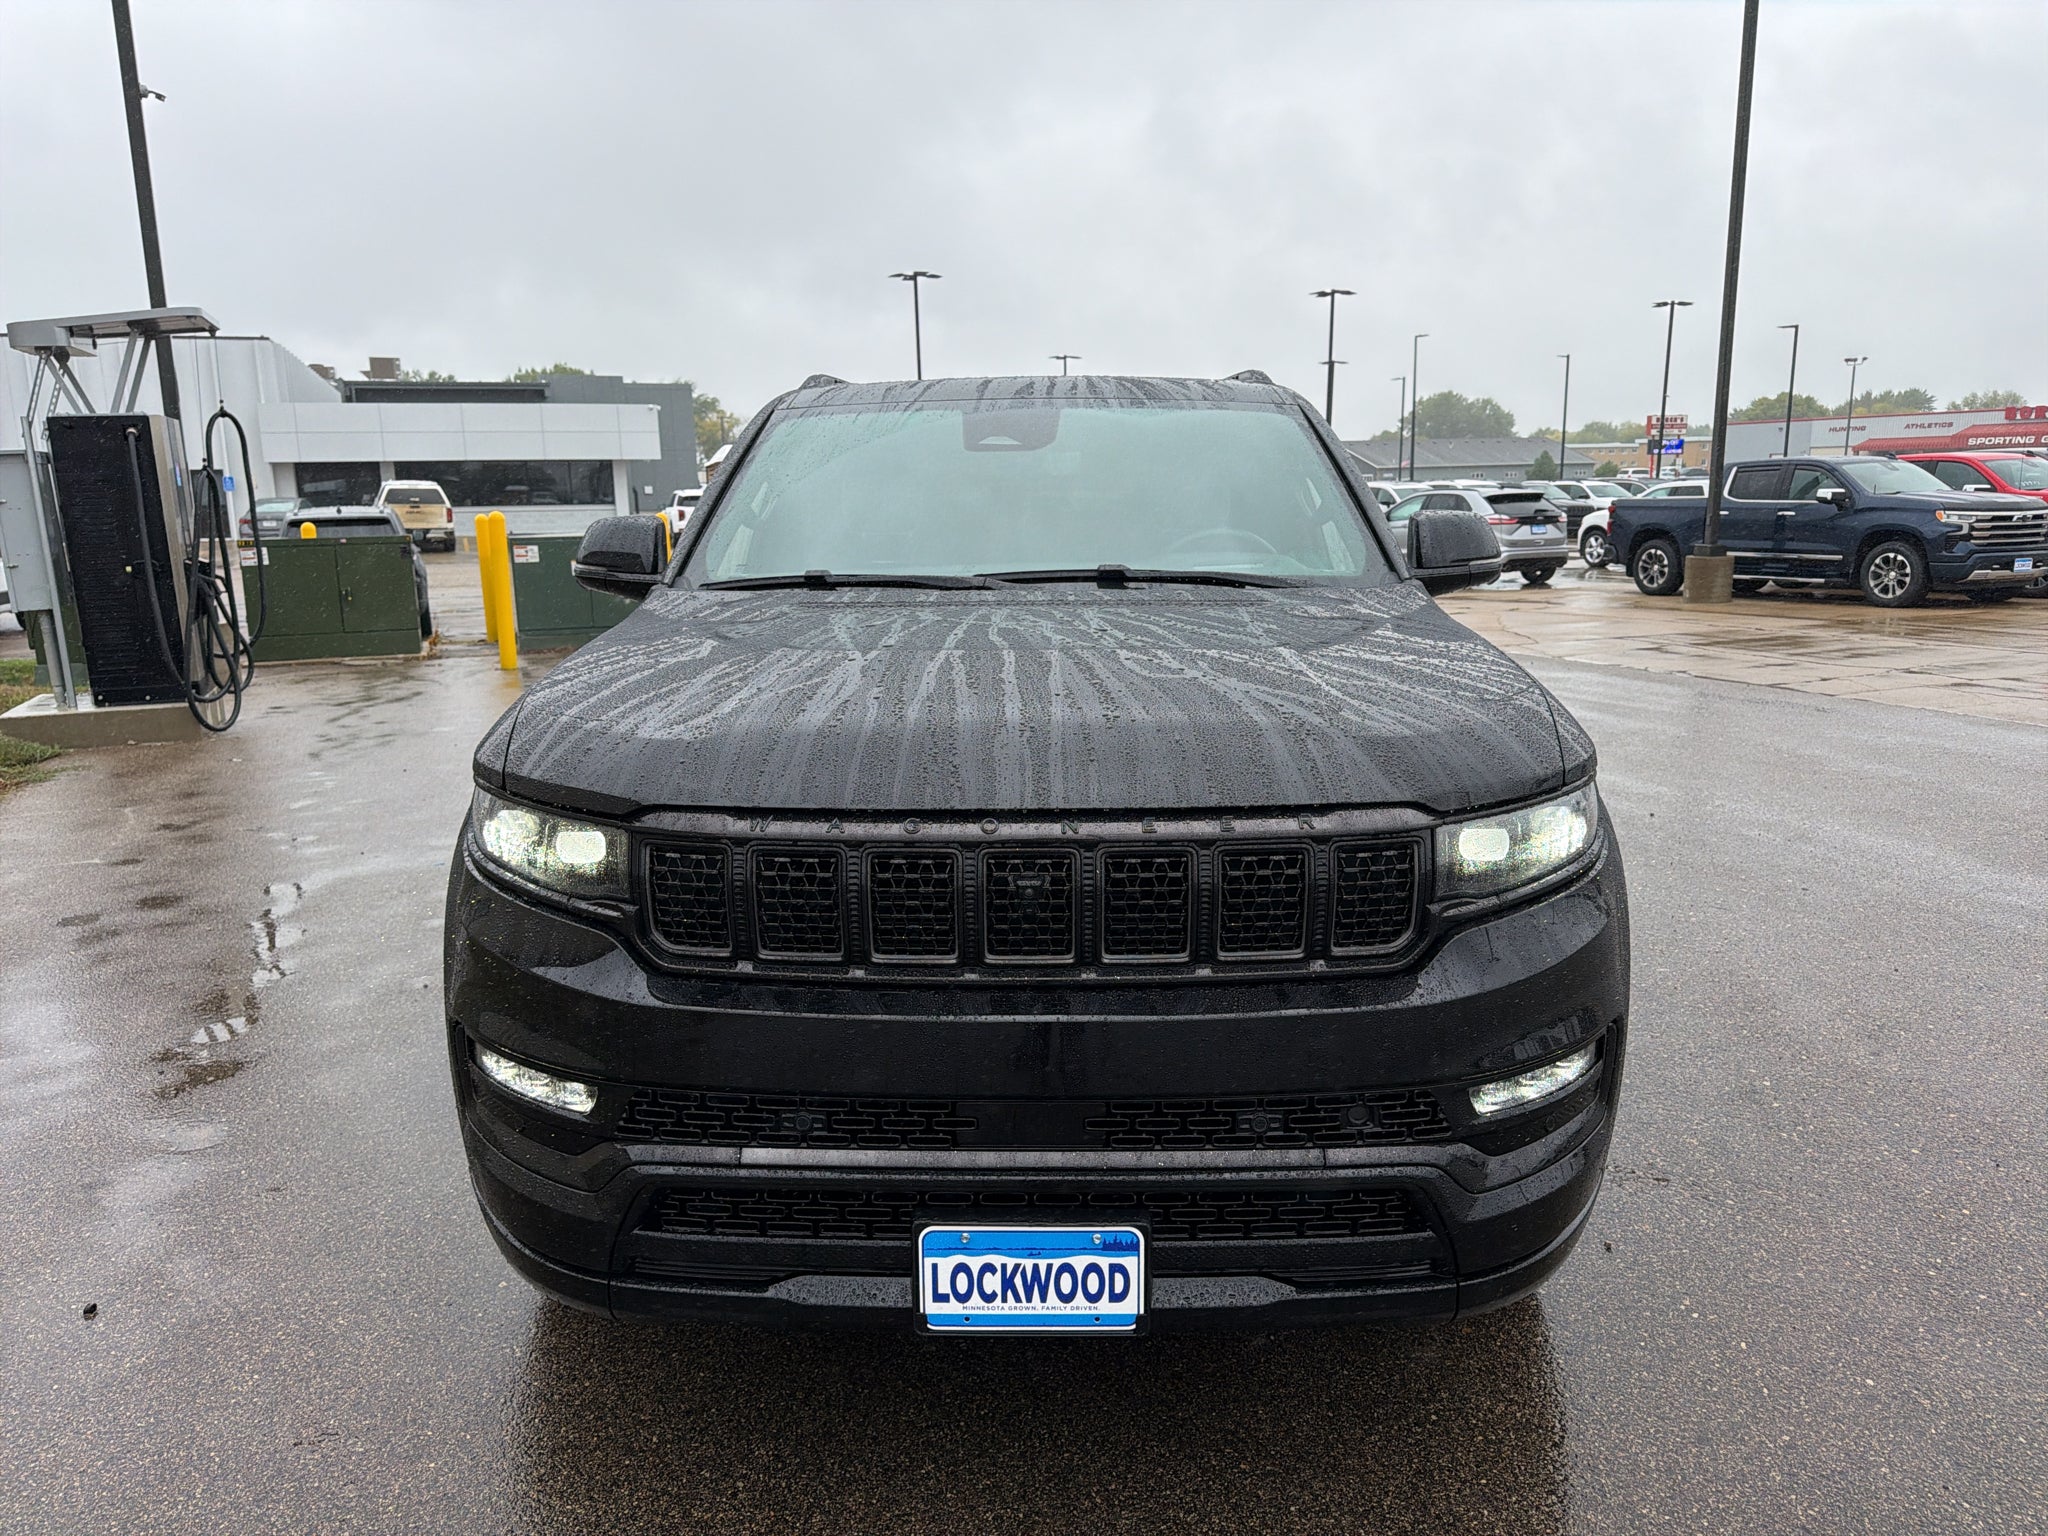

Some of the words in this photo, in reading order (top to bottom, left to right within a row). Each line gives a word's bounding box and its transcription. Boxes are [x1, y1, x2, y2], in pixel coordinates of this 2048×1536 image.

[1904, 421, 1954, 430] ATHLETICS
[1968, 435, 2036, 445] SPORTING
[747, 811, 1317, 835] WAGONEER
[931, 1261, 1131, 1304] LOCKWOOD
